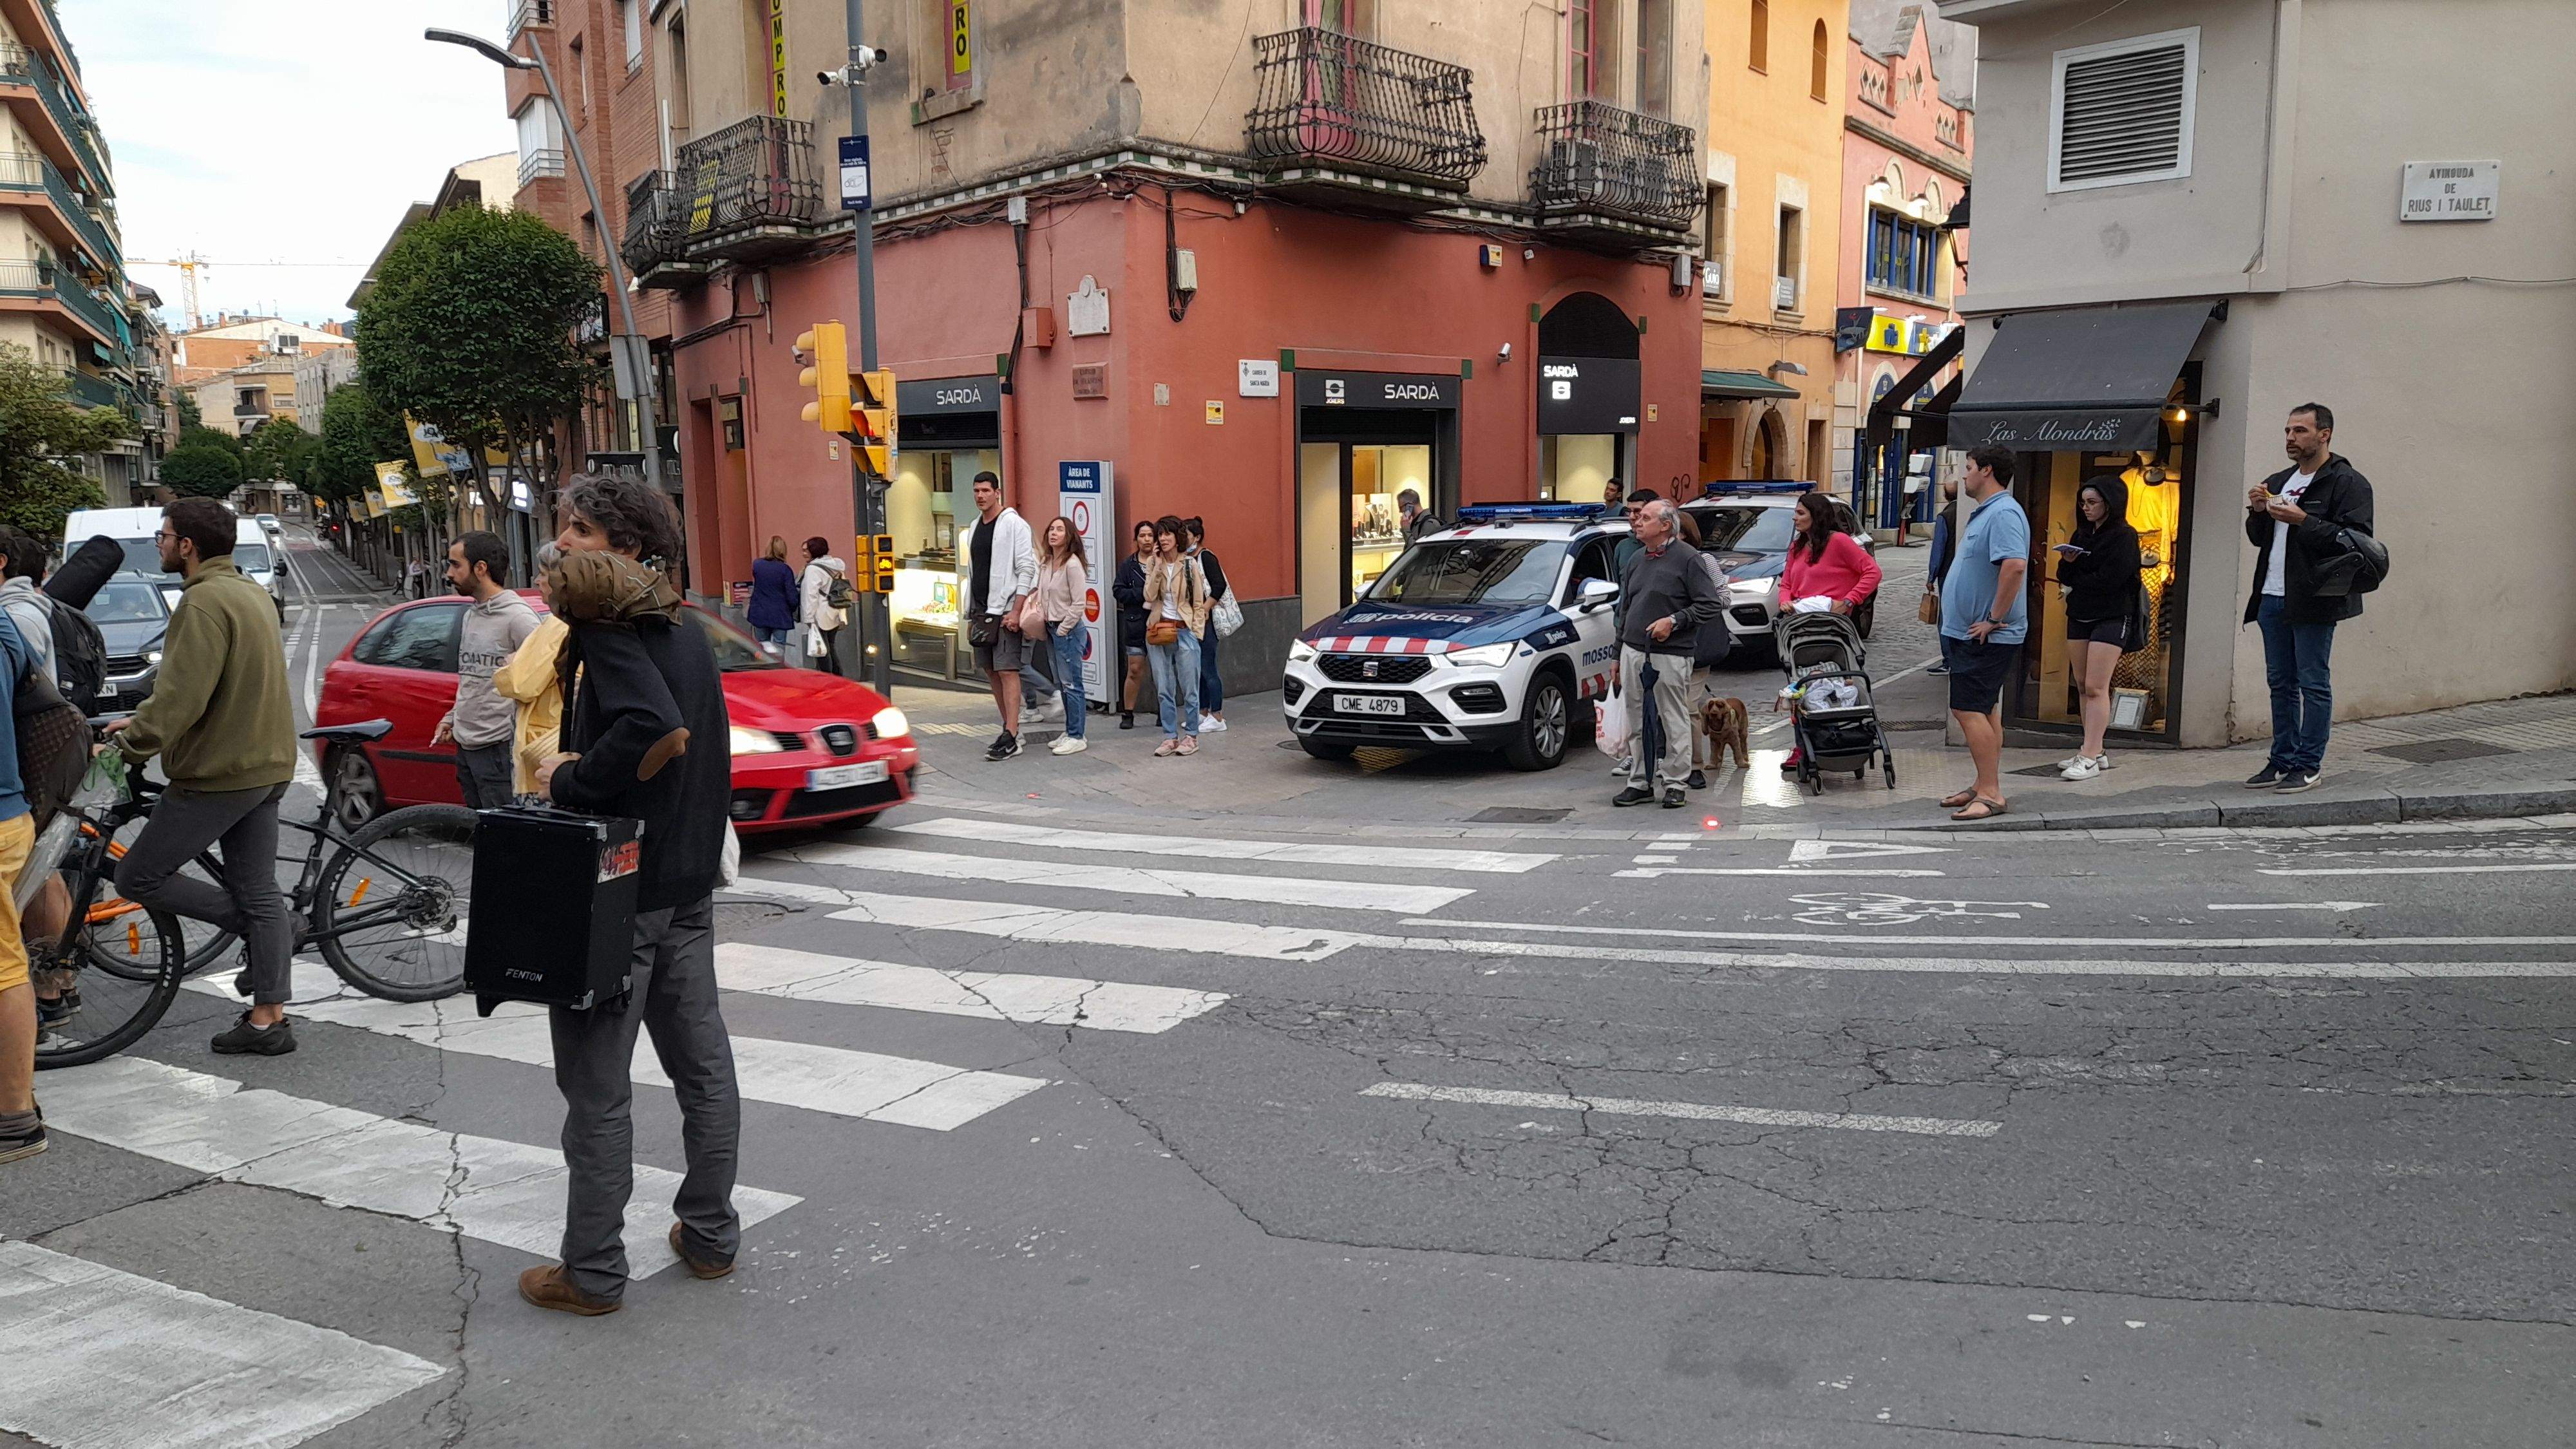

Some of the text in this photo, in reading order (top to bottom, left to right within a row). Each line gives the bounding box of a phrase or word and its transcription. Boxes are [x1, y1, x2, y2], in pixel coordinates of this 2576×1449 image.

[2445, 183, 2456, 194] DE
[2408, 197, 2490, 213] RIUS I TAULET
[1544, 363, 1578, 377] SARDÀ
[936, 383, 982, 405] SARDÀ
[1384, 381, 1440, 400] SARDÀ
[1981, 419, 2117, 445] Las Alondras
[1068, 466, 1090, 477] ÀREA DE
[1066, 479, 1093, 489] VIANANTS
[1374, 612, 1474, 624] policia
[1341, 697, 1398, 712] CME 4879
[505, 968, 544, 982] FENTON
